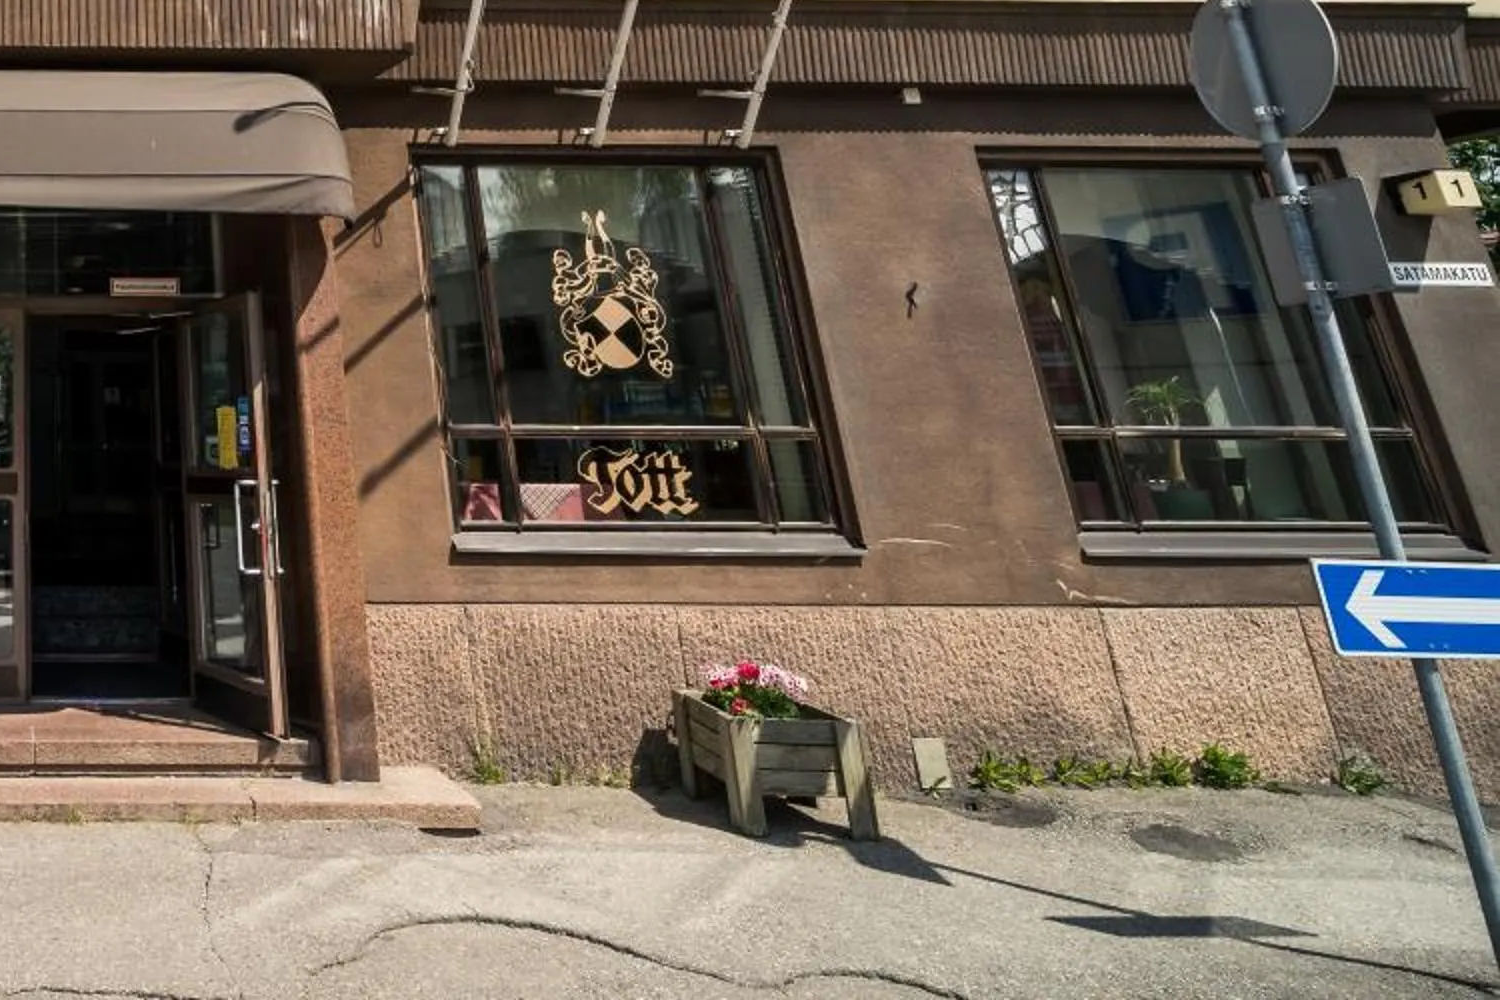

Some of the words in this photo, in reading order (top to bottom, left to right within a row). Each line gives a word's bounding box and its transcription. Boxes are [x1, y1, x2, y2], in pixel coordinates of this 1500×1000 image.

[1412, 181, 1427, 200] 1
[1450, 179, 1465, 198] 1
[1393, 266, 1488, 282] SATAMAKATU
[577, 445, 700, 515] Tott
